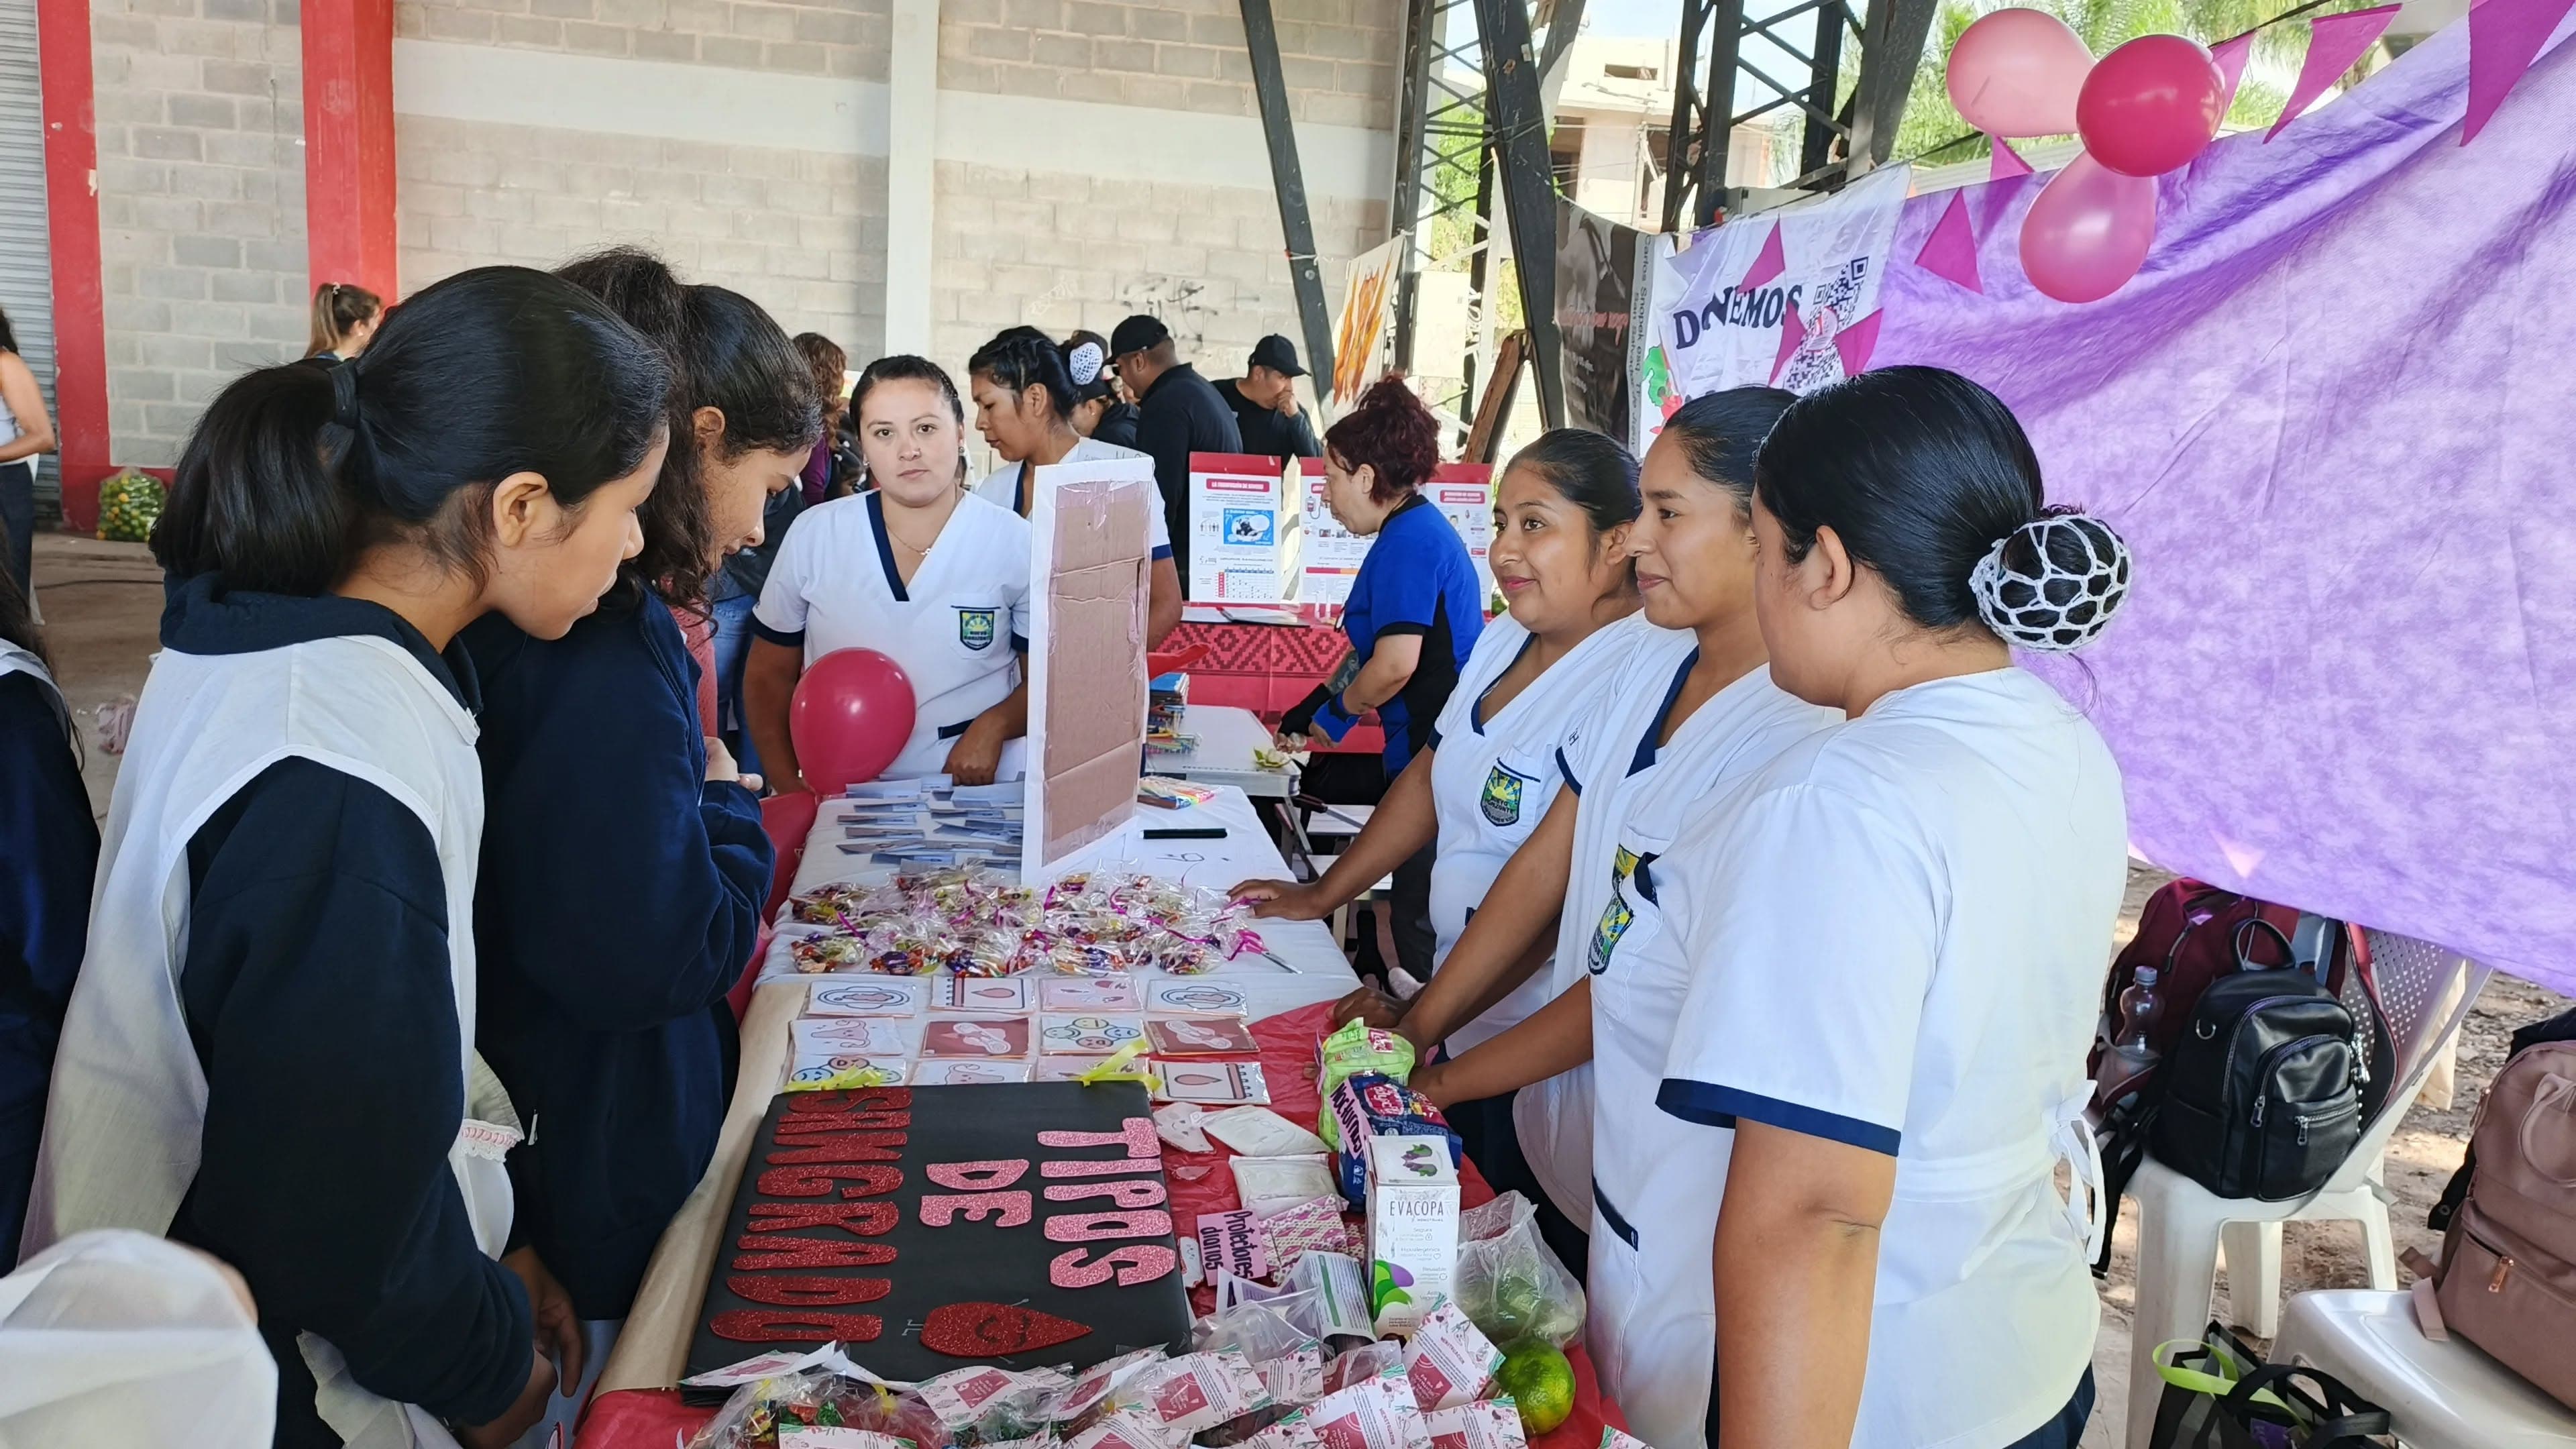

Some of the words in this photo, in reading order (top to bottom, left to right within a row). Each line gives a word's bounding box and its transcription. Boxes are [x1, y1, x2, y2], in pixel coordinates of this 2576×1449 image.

[1673, 284, 1803, 350] DNEMOS
[708, 1086, 913, 1342] SANGRADO
[918, 1159, 1032, 1228] DE
[1037, 1117, 1177, 1288] TIPOS
[1389, 1200, 1444, 1216] EVACOPA
[1199, 1226, 1224, 1271] diarios
[1224, 1210, 1258, 1279] Protectores
